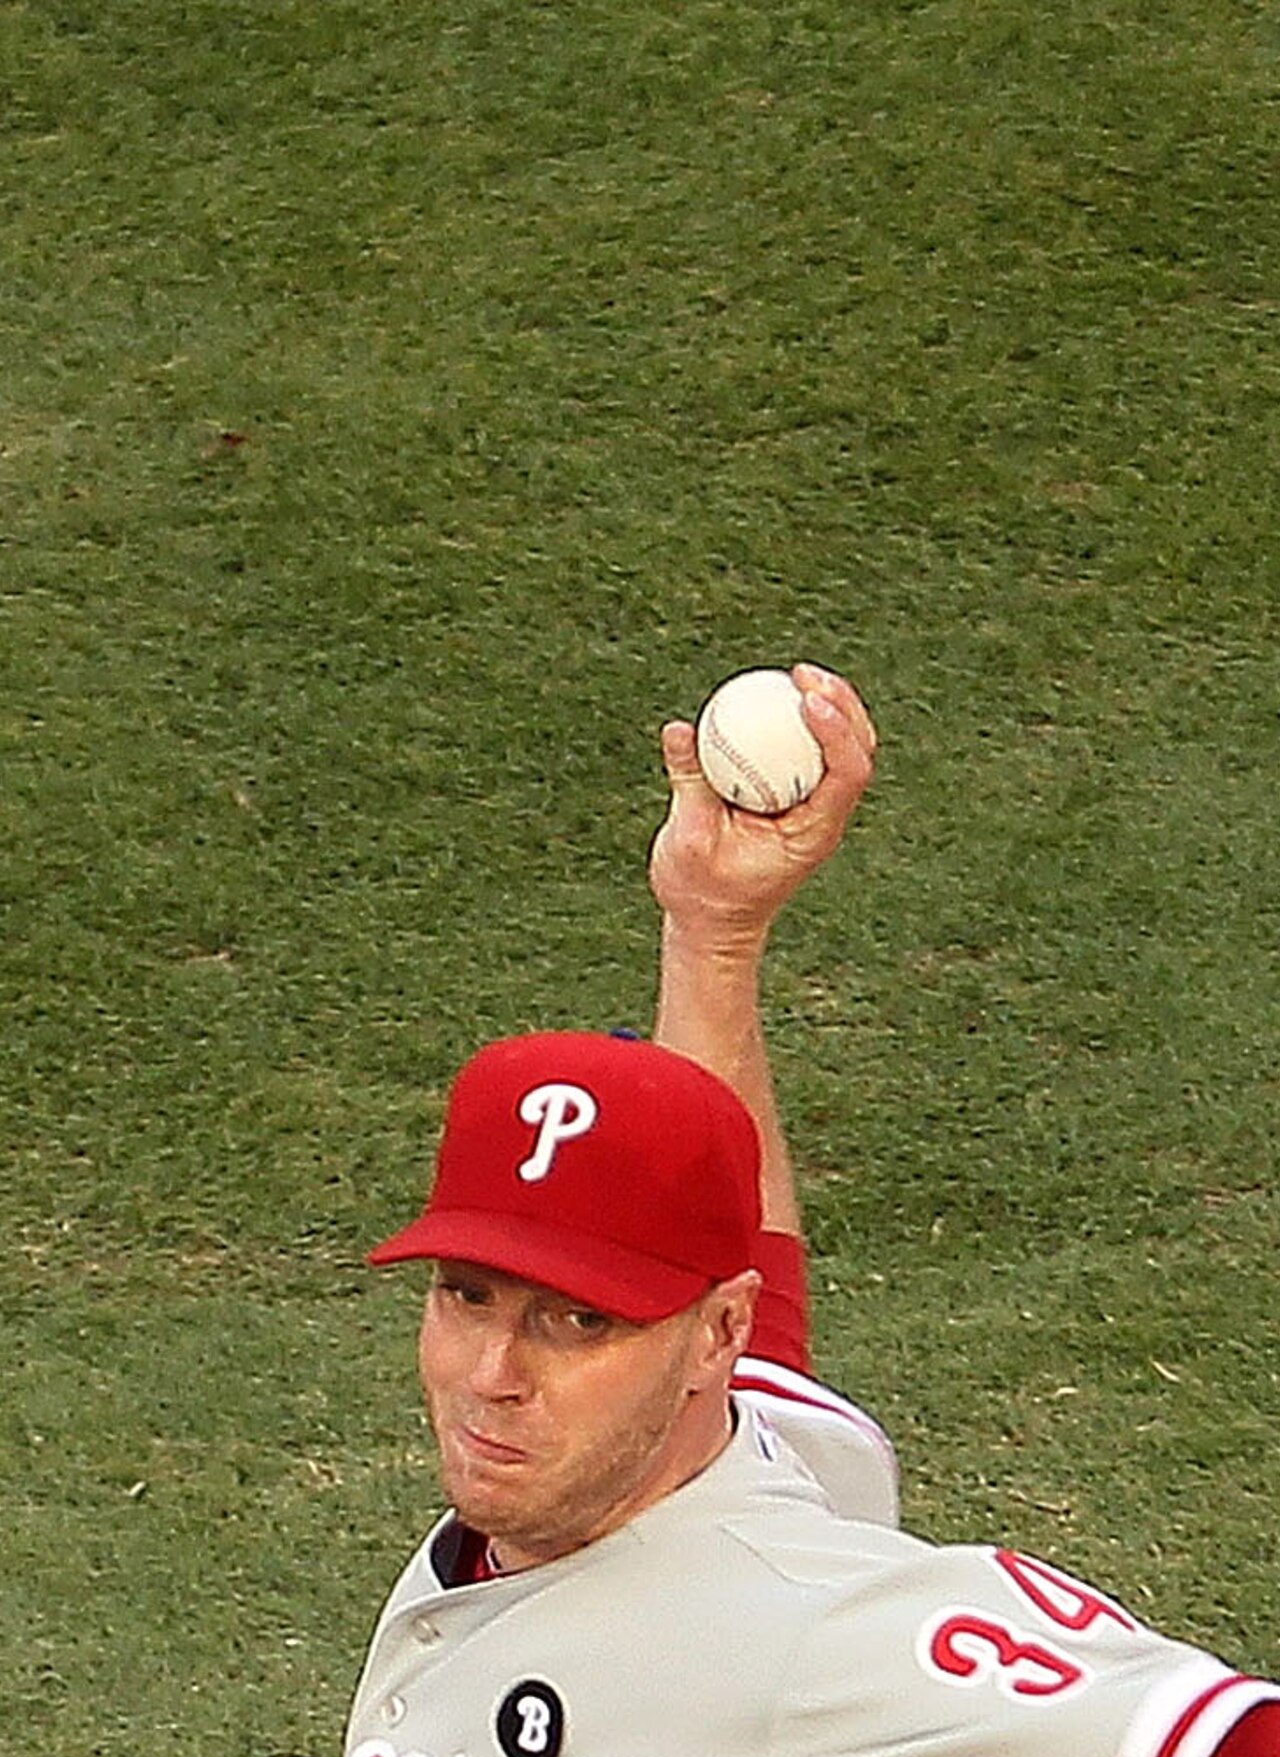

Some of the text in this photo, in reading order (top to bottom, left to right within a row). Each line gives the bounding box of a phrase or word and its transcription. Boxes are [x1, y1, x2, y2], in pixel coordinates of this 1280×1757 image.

[518, 1081, 600, 1184] P
[925, 1547, 1137, 1699] 34
[516, 1694, 551, 1752] B
